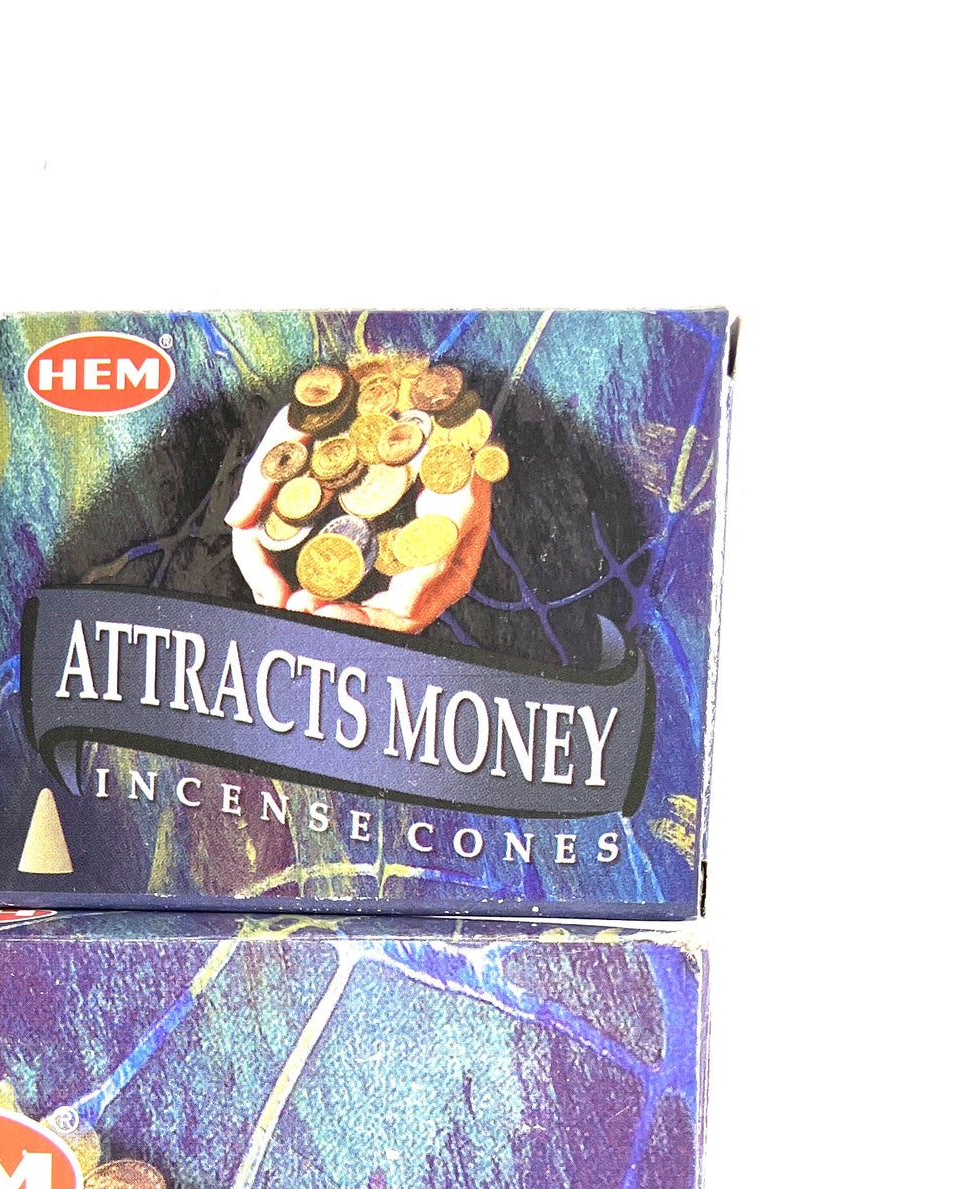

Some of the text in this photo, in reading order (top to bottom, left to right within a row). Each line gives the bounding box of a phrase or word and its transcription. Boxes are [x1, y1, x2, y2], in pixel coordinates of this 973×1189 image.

[38, 357, 160, 391] HEM
[55, 619, 619, 787] ATTRACTS MONEY
[95, 768, 620, 864] INCENSE CONES
